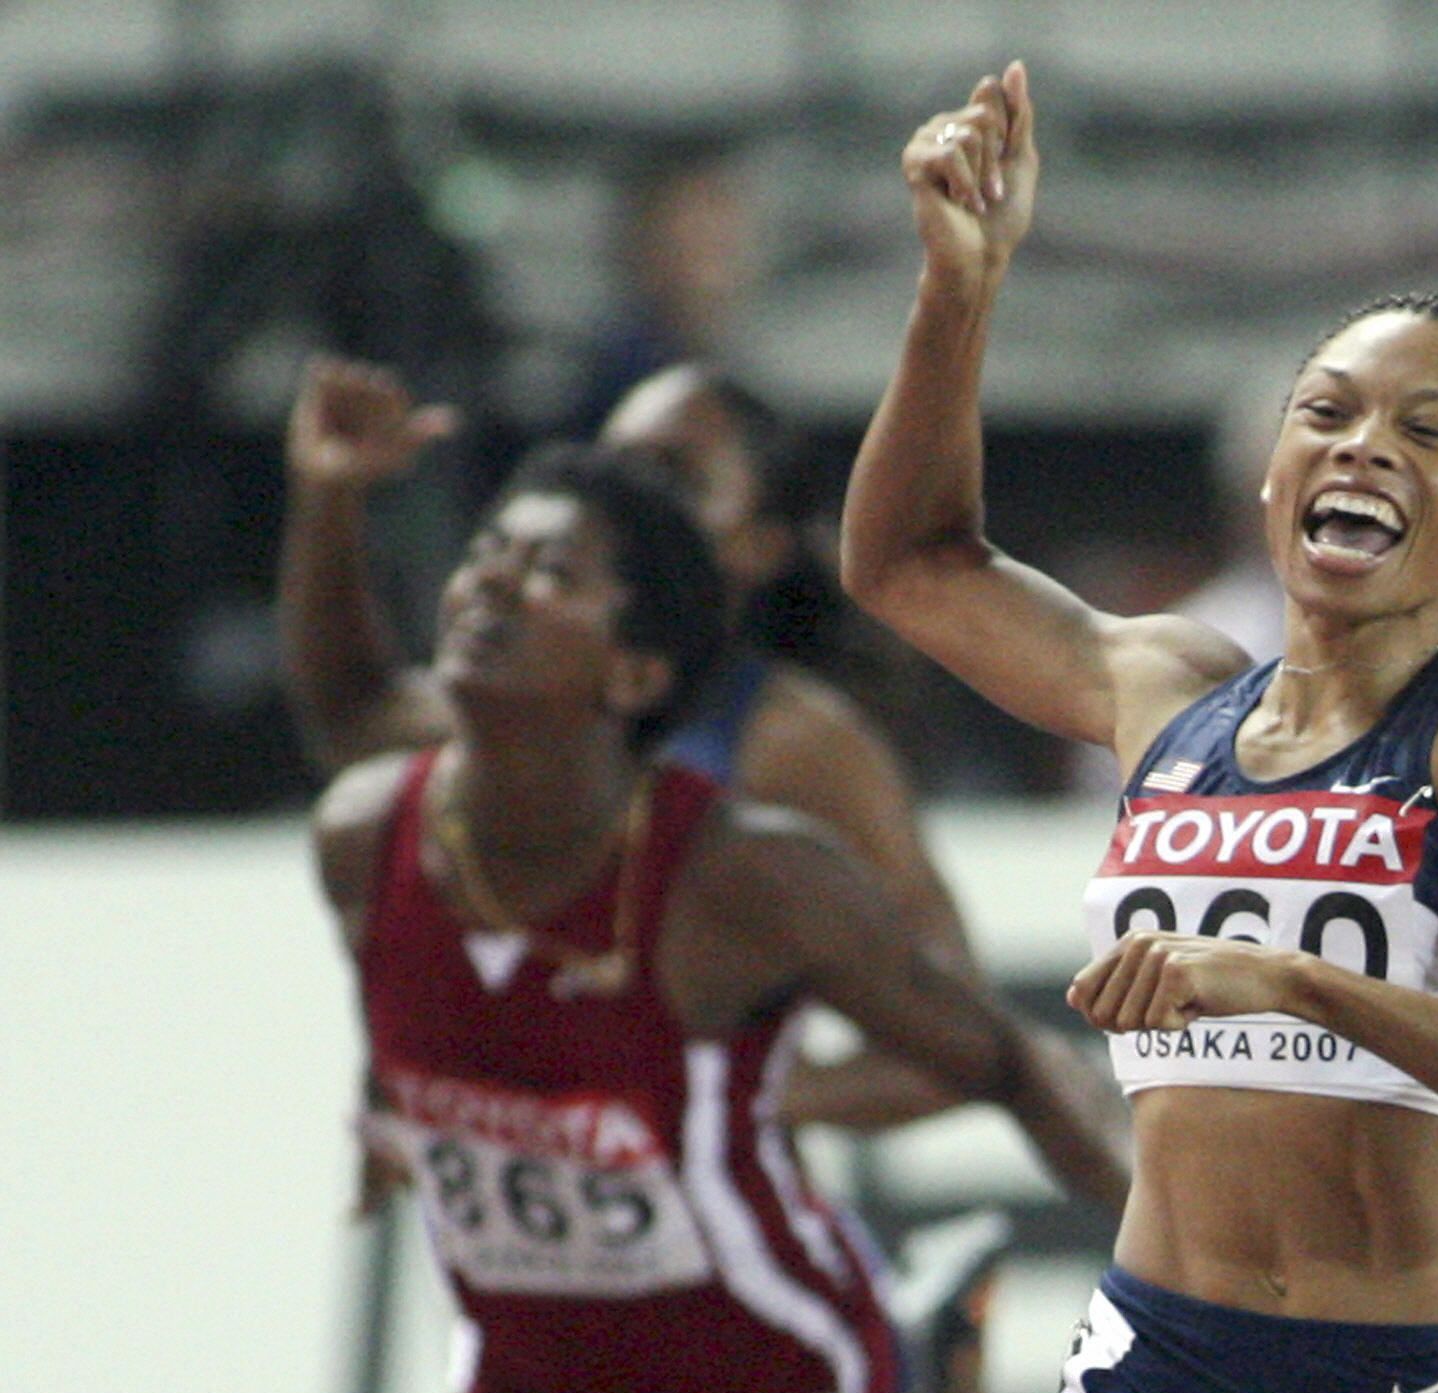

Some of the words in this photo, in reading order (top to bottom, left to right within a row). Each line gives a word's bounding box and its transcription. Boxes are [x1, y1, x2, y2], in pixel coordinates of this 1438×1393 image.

[1123, 807, 1404, 872] TOYOTA
[1136, 1028, 1253, 1060] OSAKA
[1269, 1031, 1358, 1062] 2007
